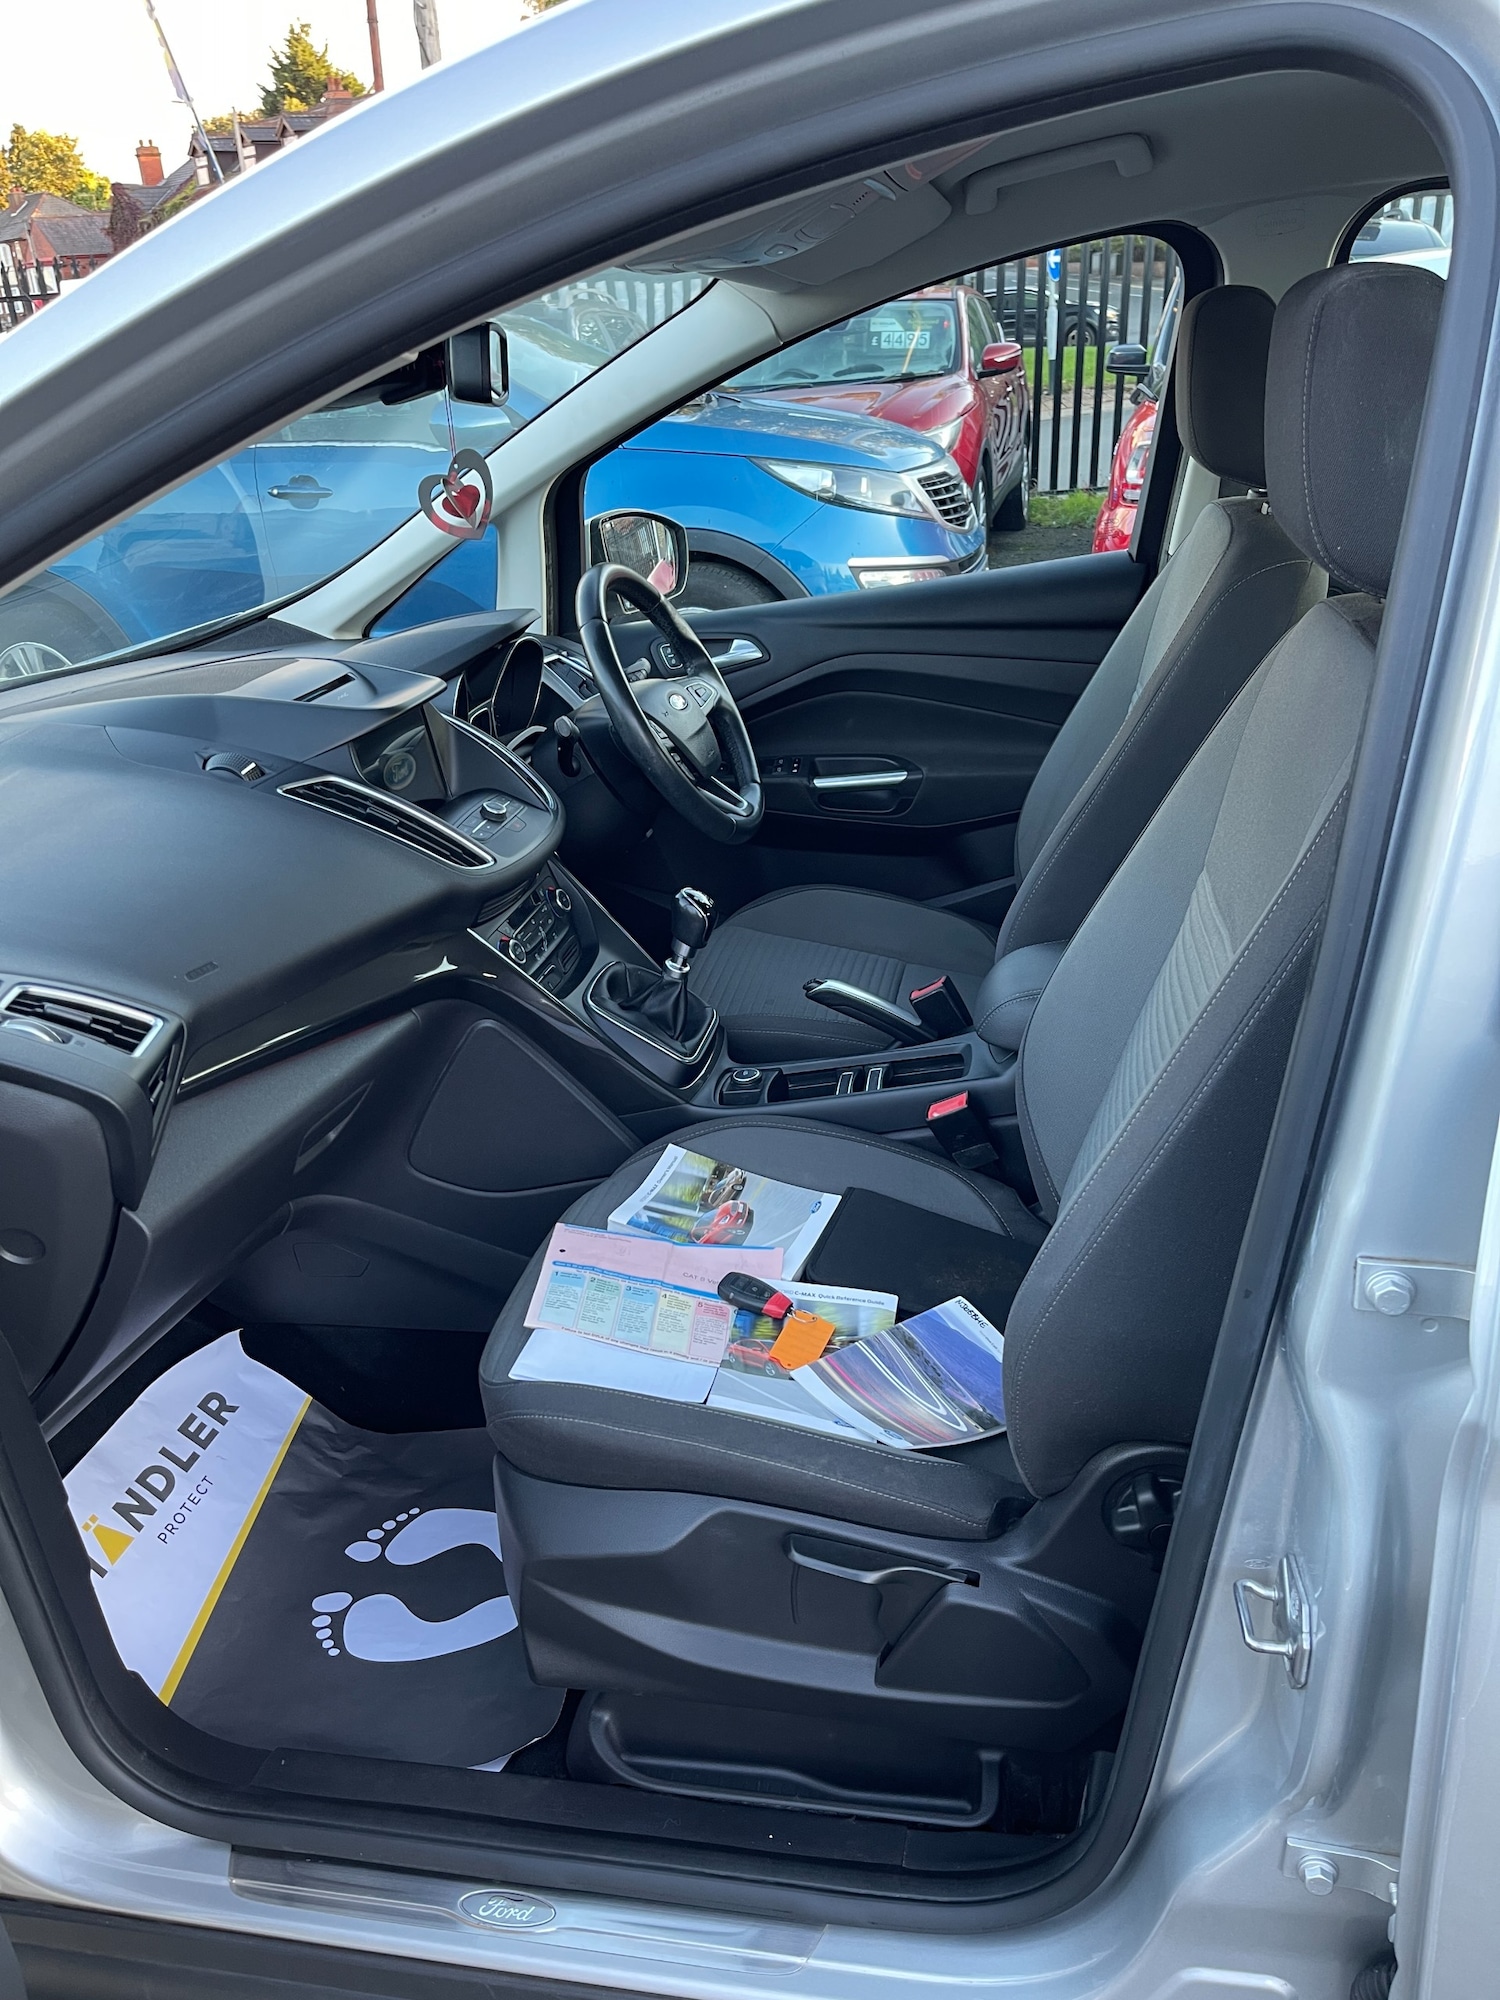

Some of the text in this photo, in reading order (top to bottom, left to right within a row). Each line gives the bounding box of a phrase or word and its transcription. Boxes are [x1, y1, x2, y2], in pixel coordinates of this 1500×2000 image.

[794, 1289, 816, 1298] C-MAX
[156, 1474, 214, 1545] PROTECT
[478, 1895, 536, 1921] Ford
